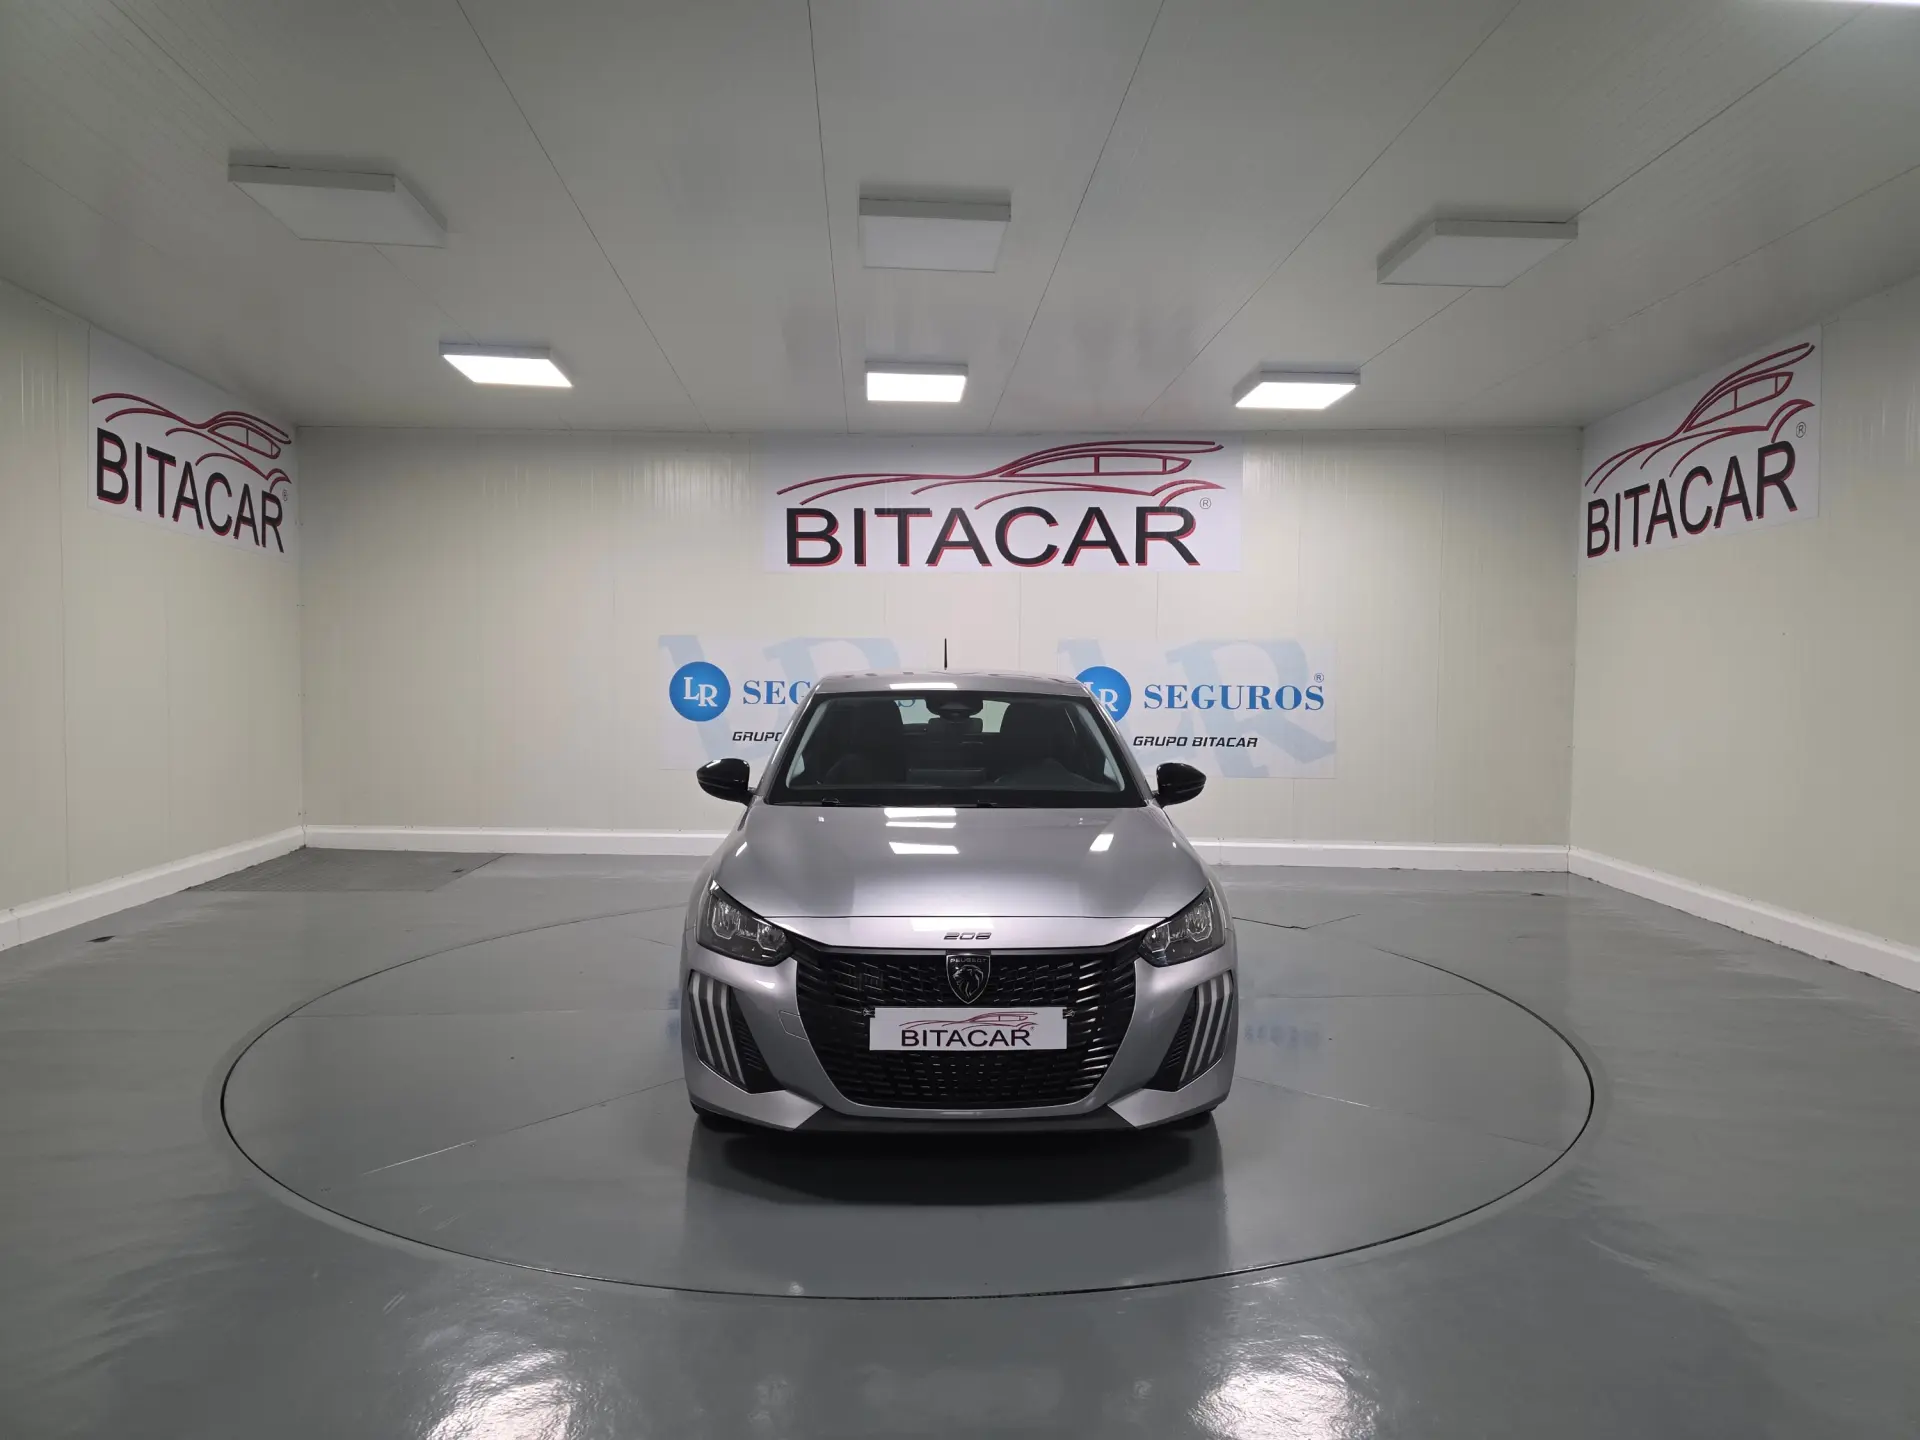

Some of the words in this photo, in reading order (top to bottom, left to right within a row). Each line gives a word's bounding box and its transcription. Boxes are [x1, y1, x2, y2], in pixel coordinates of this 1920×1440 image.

[97, 427, 285, 553] BITACAR
[1587, 440, 1798, 559] BITACAR
[786, 506, 1201, 568] BITACAR
[683, 676, 718, 707] LR
[1143, 684, 1325, 711] SEGUROS
[1133, 736, 1188, 748] GRUPO
[1191, 736, 1259, 748] BITACAR
[943, 932, 992, 940] 208
[901, 1029, 1032, 1047] BITACAR
